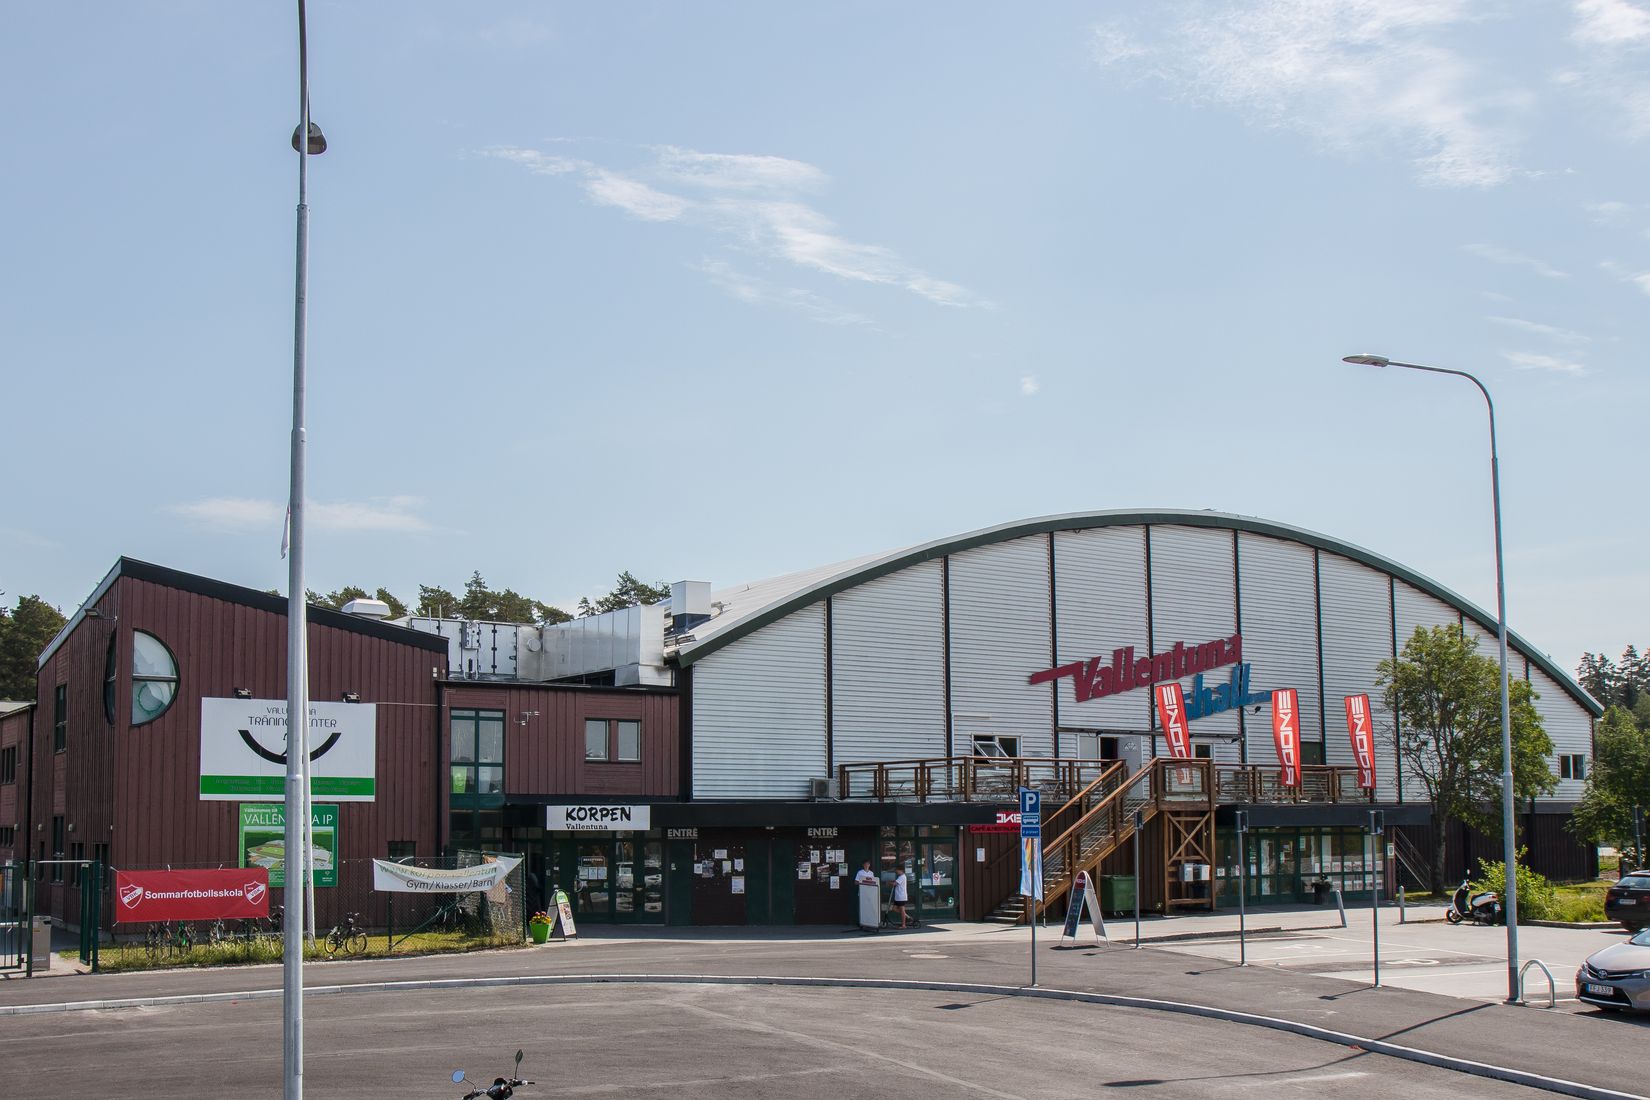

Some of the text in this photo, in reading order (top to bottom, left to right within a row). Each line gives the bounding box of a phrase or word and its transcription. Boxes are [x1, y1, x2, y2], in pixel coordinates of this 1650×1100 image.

[1030, 634, 1242, 703] Vallentuna
[1025, 793, 1037, 812] P
[322, 814, 333, 825] IP
[565, 806, 632, 822] KORPEN
[667, 827, 698, 837] ENTRÉ
[807, 826, 838, 836] ENTRÉ
[144, 889, 243, 900] Sommarfotbollsskola
